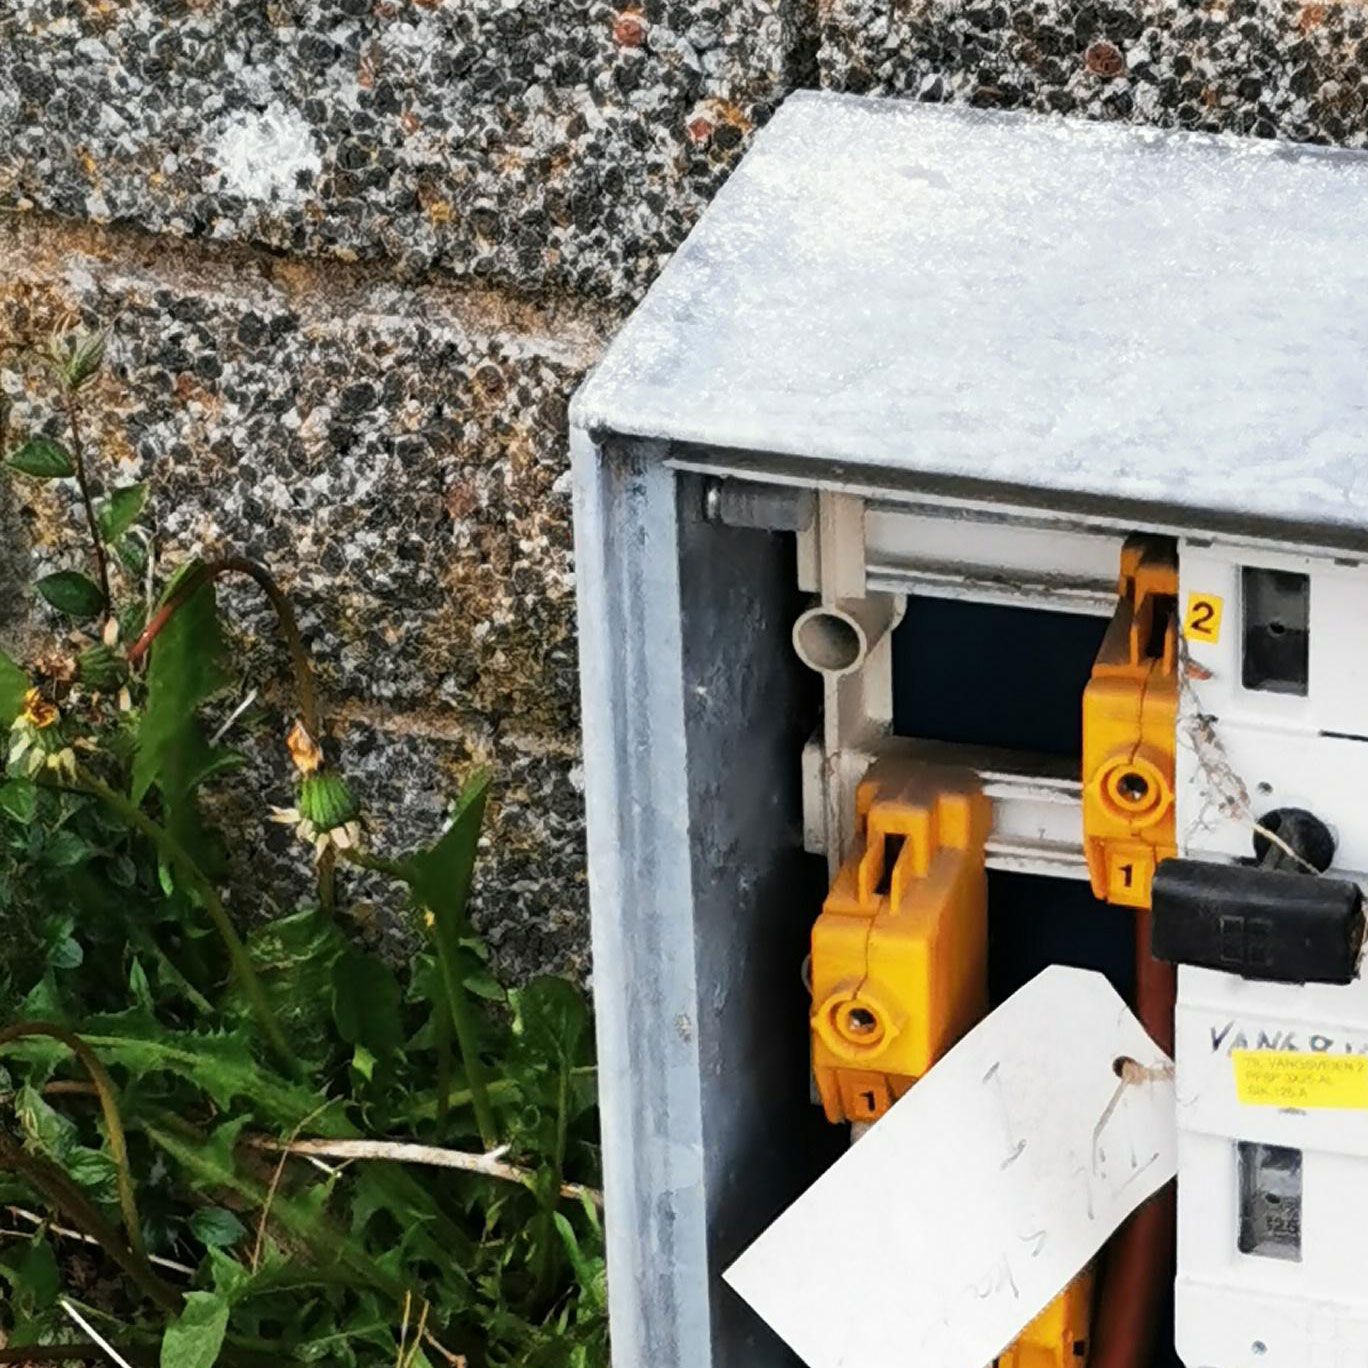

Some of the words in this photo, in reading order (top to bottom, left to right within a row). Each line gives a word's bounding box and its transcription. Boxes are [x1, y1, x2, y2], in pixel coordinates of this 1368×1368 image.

[1190, 602, 1214, 633] 2
[1118, 864, 1132, 888] 1
[859, 1090, 876, 1112] 1
